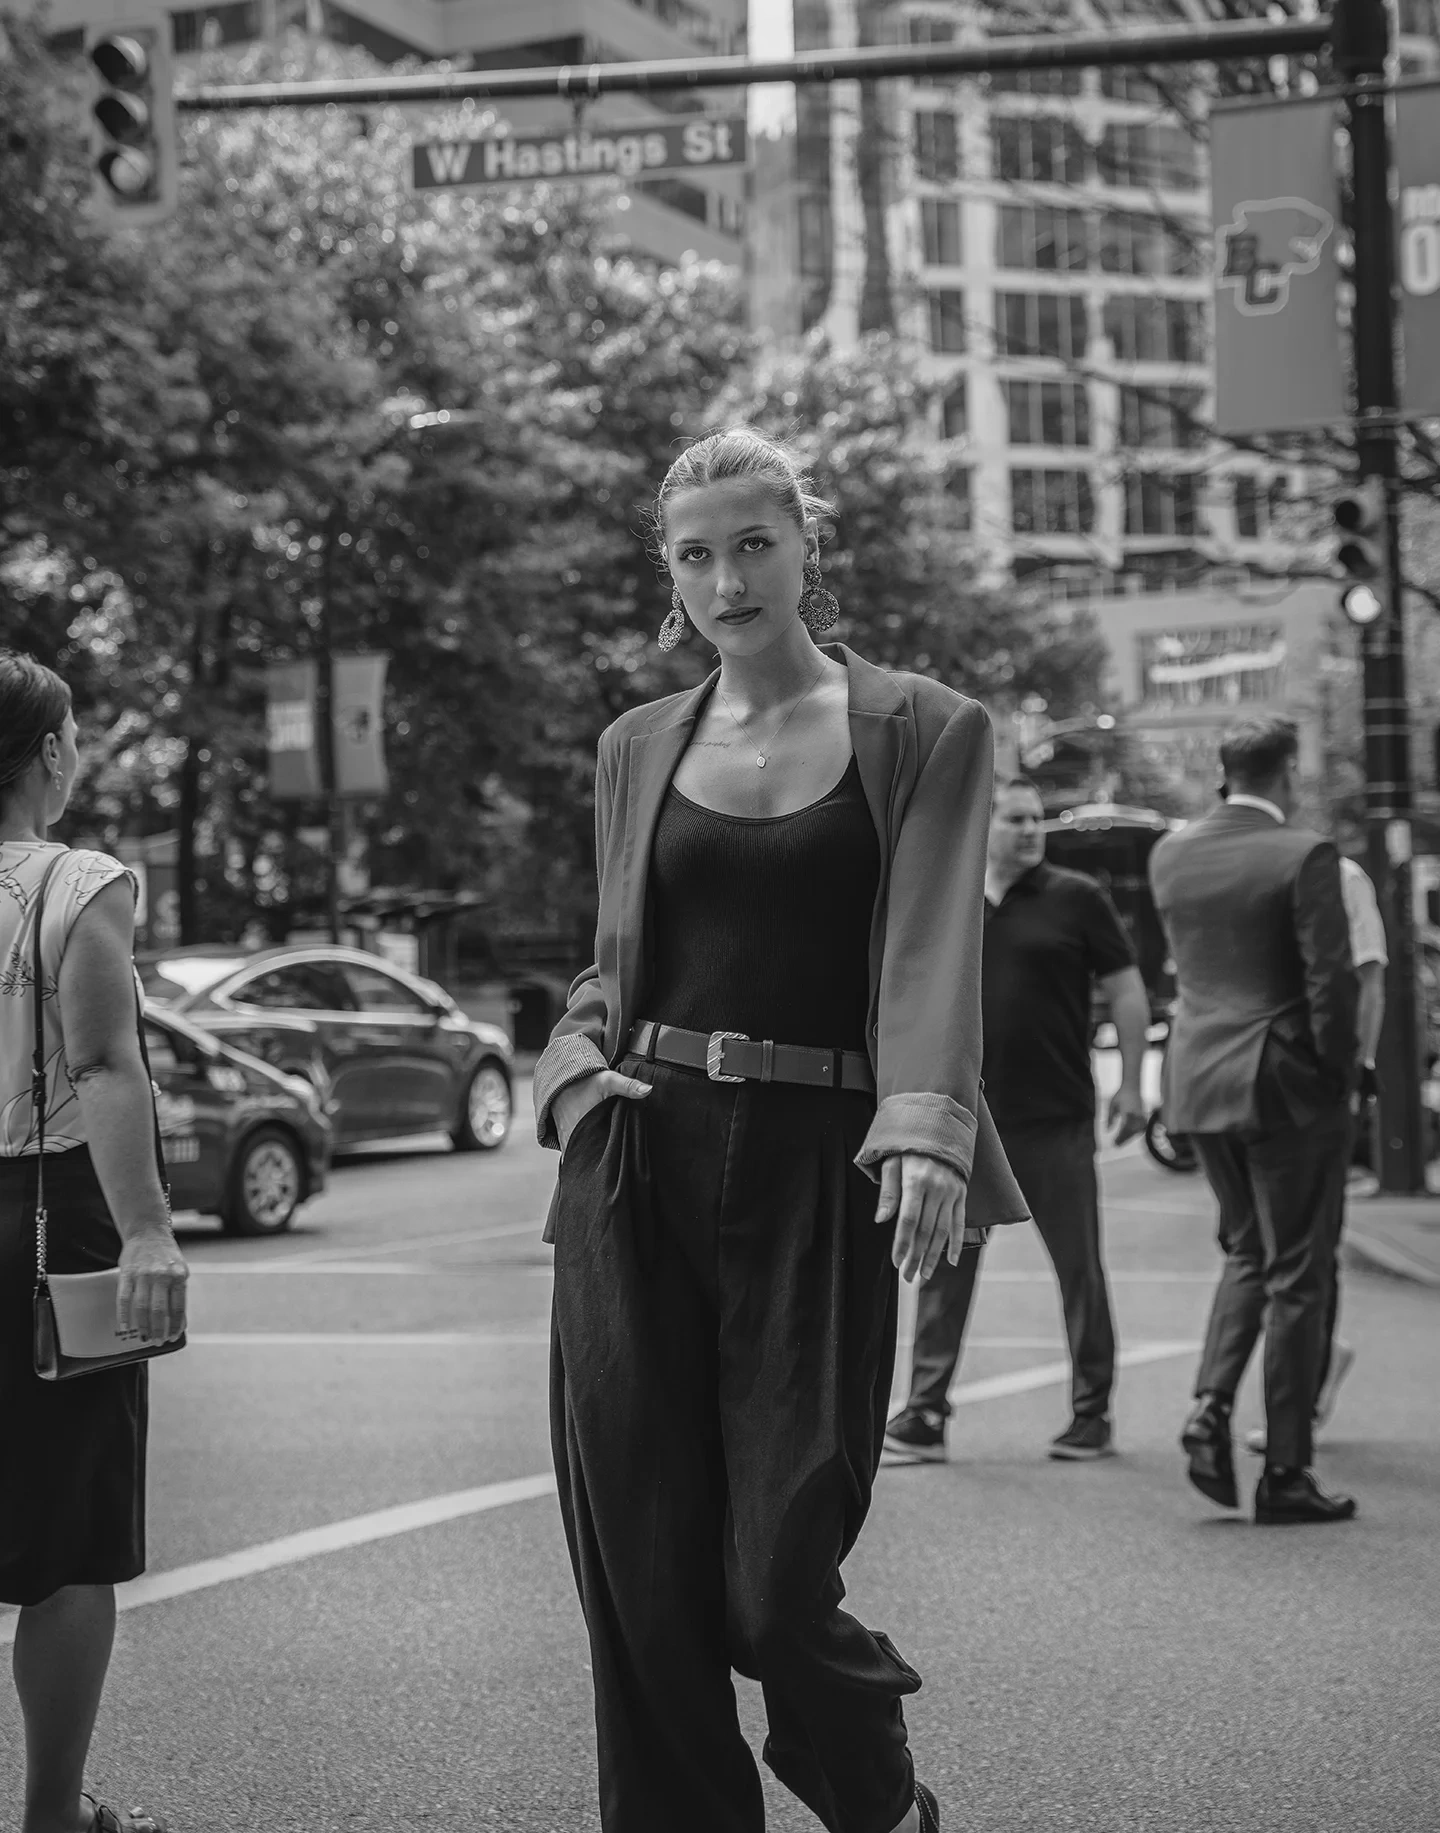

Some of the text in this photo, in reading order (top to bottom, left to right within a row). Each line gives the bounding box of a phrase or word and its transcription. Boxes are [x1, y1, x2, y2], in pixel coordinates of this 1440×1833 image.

[426, 120, 734, 184] W Hastings St
